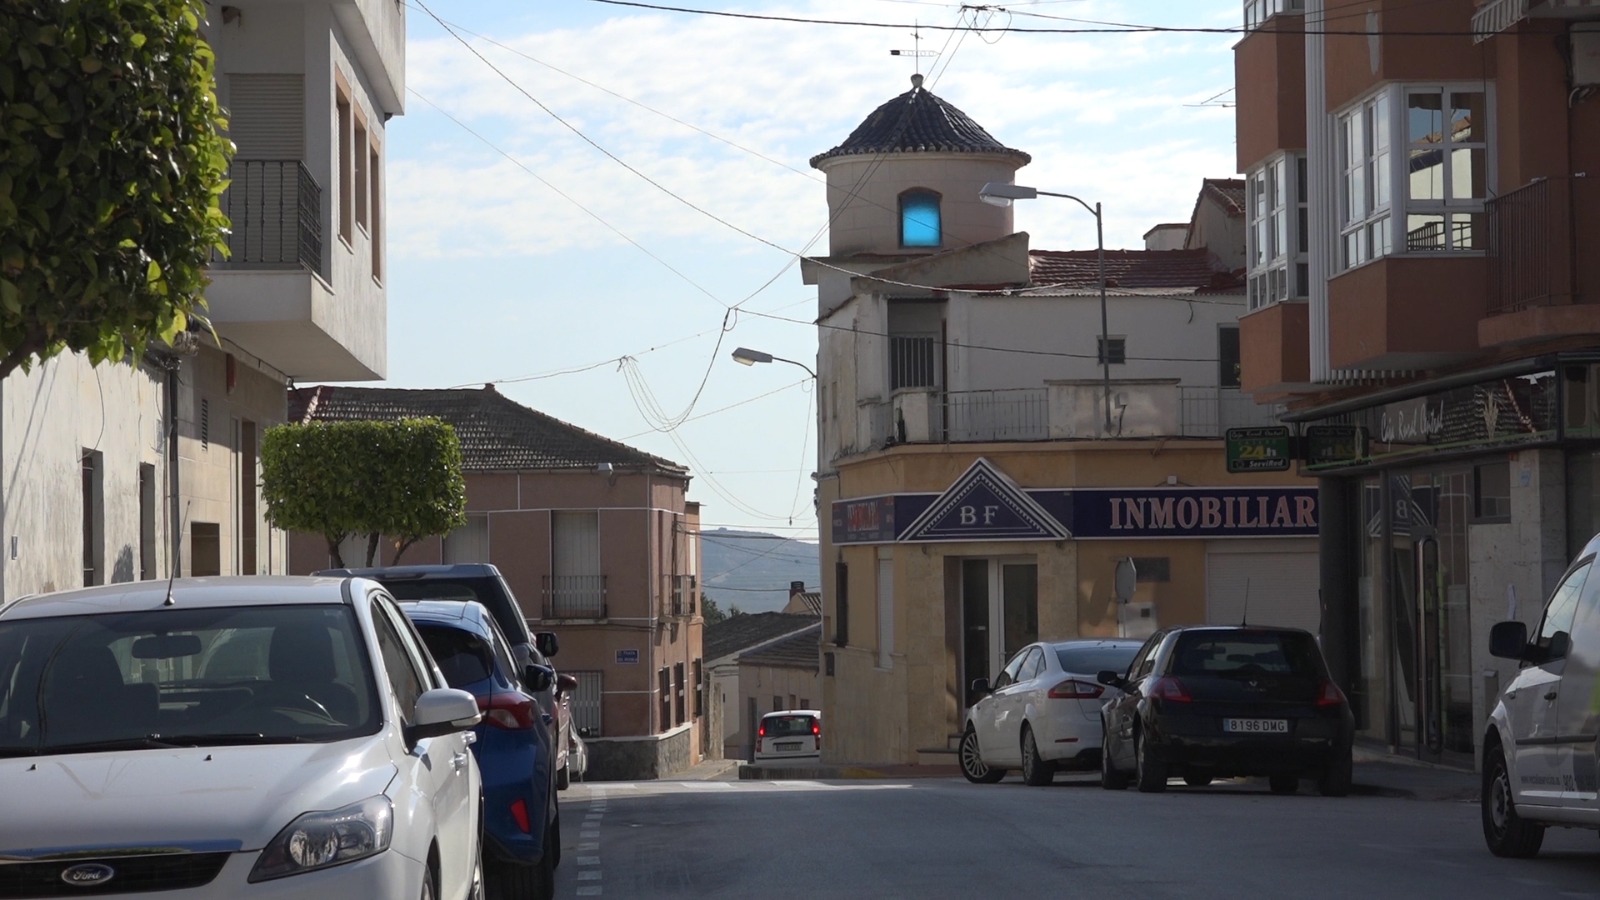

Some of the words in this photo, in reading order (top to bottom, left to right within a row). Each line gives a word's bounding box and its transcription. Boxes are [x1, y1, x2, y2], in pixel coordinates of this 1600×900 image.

[1109, 496, 1318, 529] INMOBILIAR
[1230, 720, 1260, 731] 8196
[1262, 720, 1285, 731] DMG
[73, 870, 102, 881] Ford
